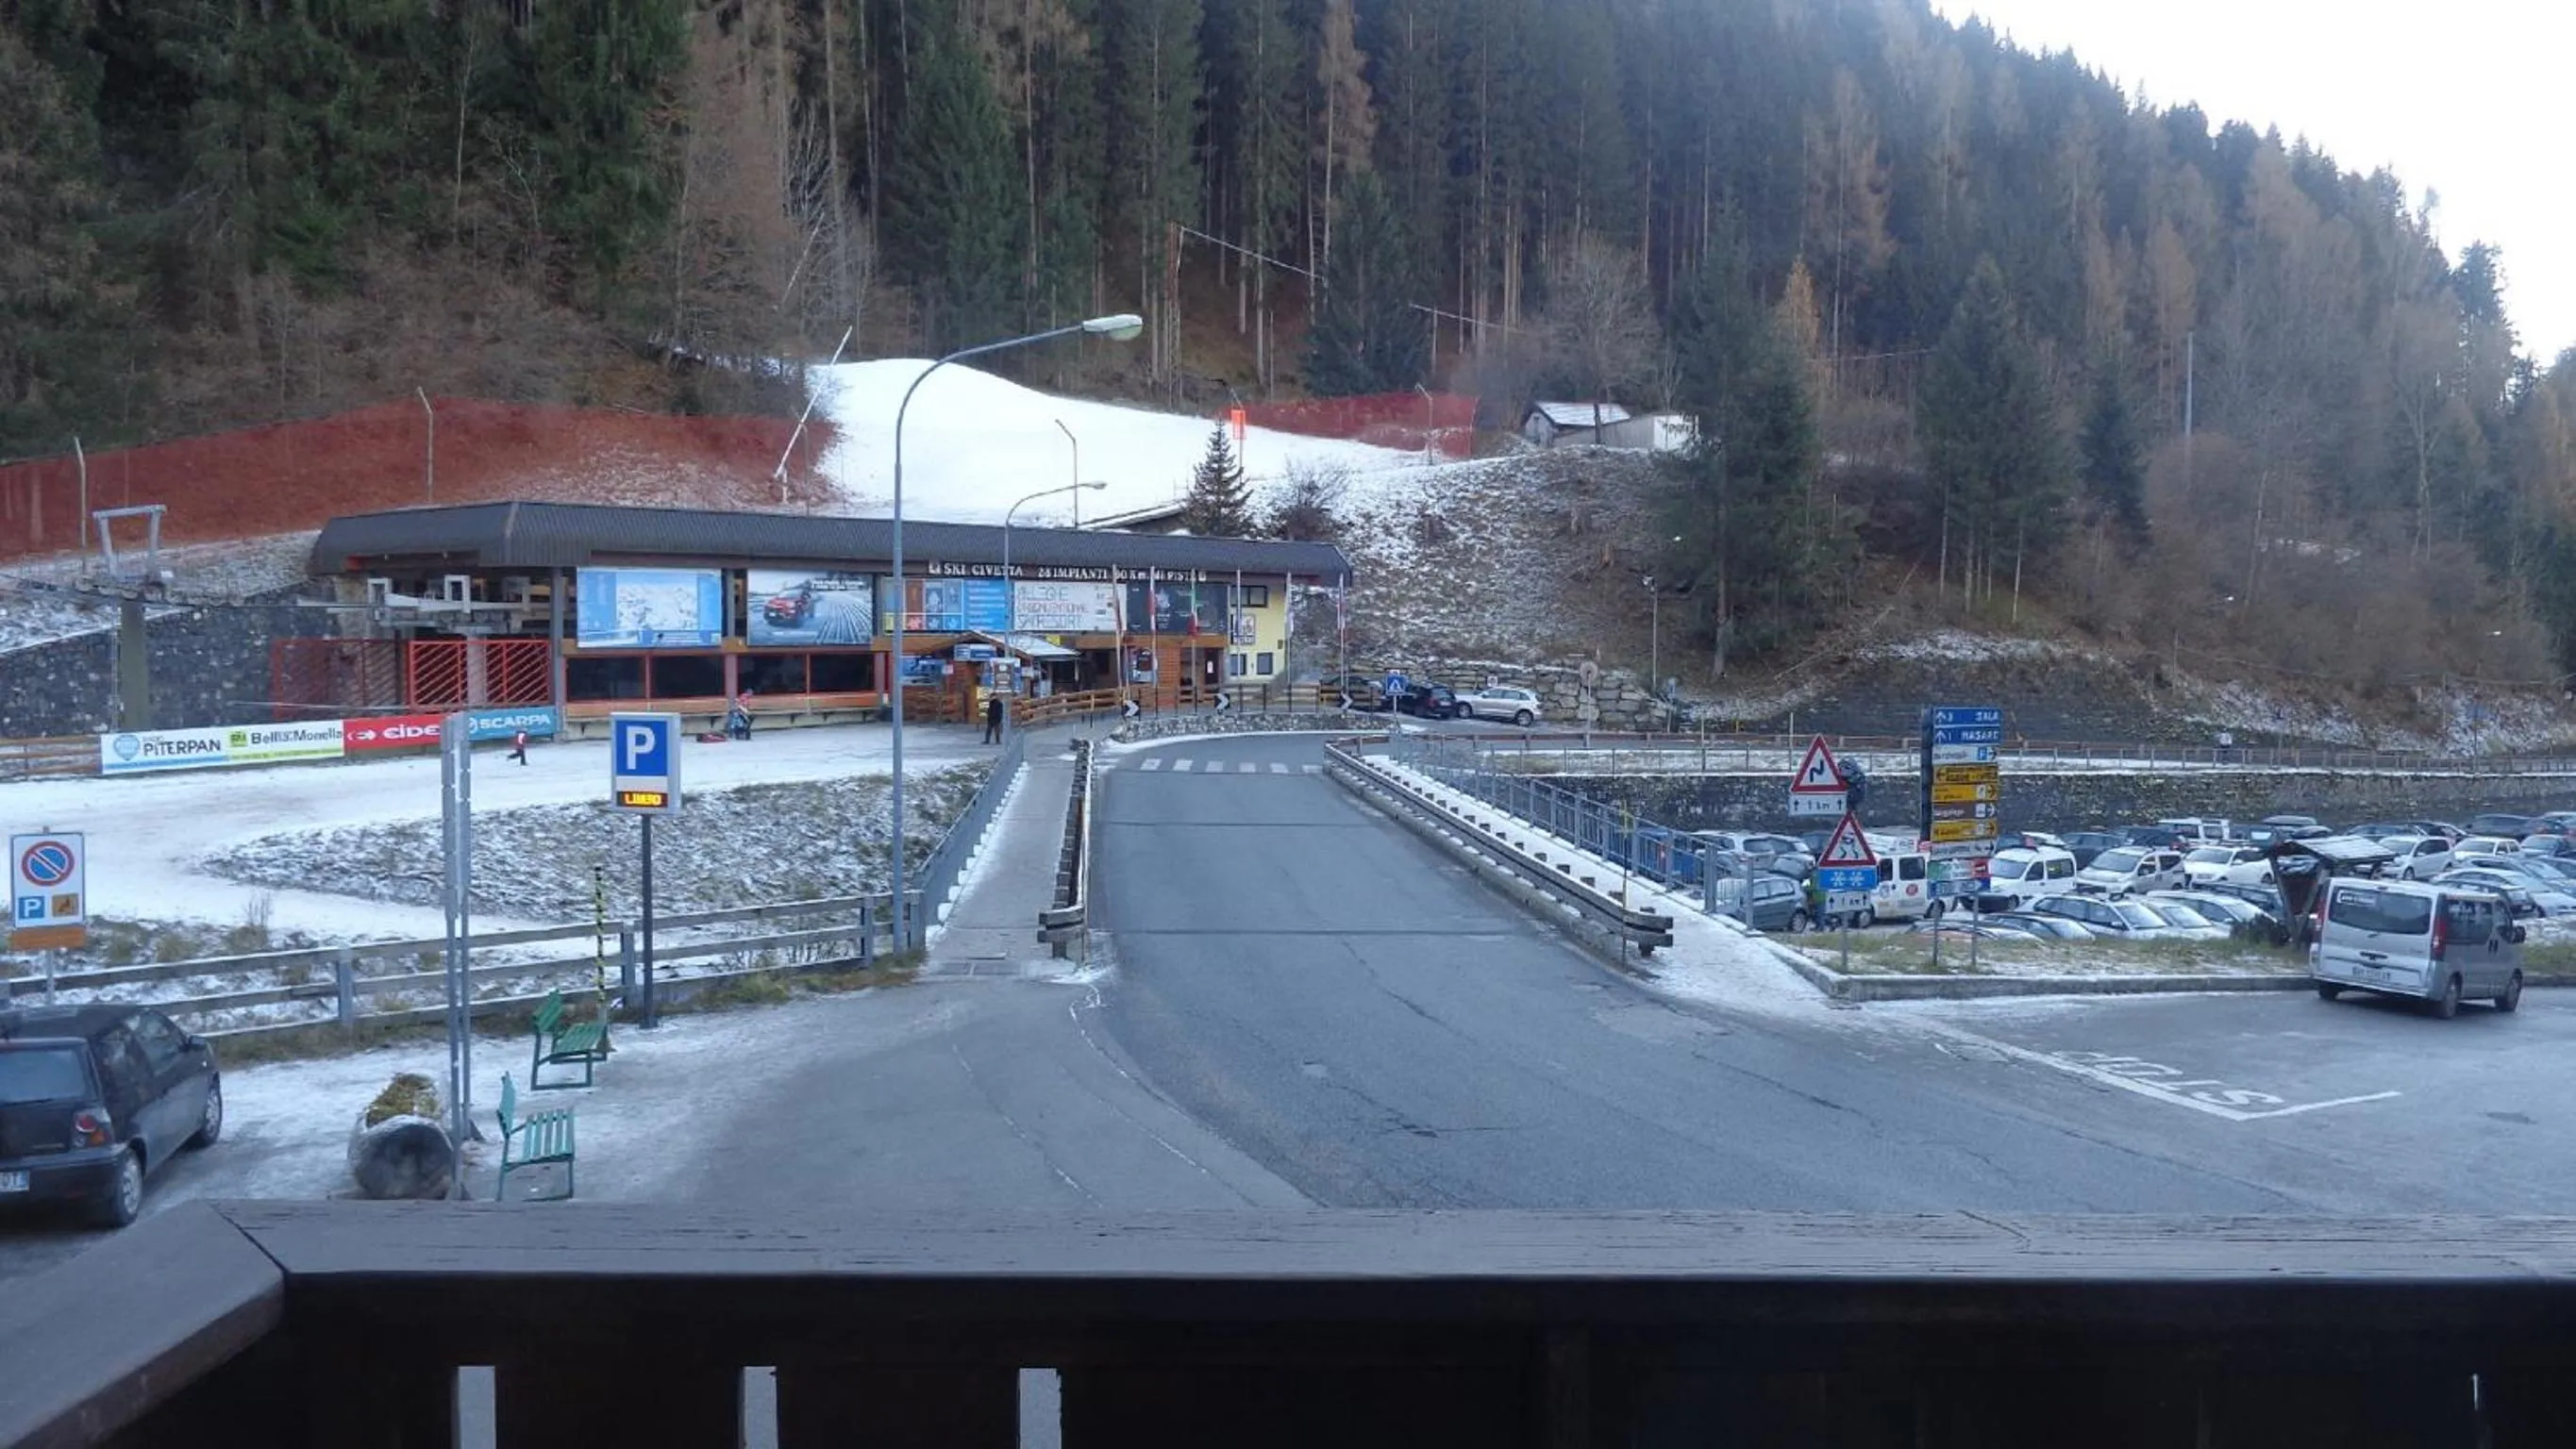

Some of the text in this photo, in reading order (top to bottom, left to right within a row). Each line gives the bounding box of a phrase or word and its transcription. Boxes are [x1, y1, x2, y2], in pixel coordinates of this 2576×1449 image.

[944, 563, 966, 575] SKI
[971, 564, 1023, 576] CIVETTA
[1053, 567, 1108, 579] IMPIANTI
[479, 713, 551, 729] SCARPA
[627, 725, 656, 770] P
[24, 899, 42, 917] P
